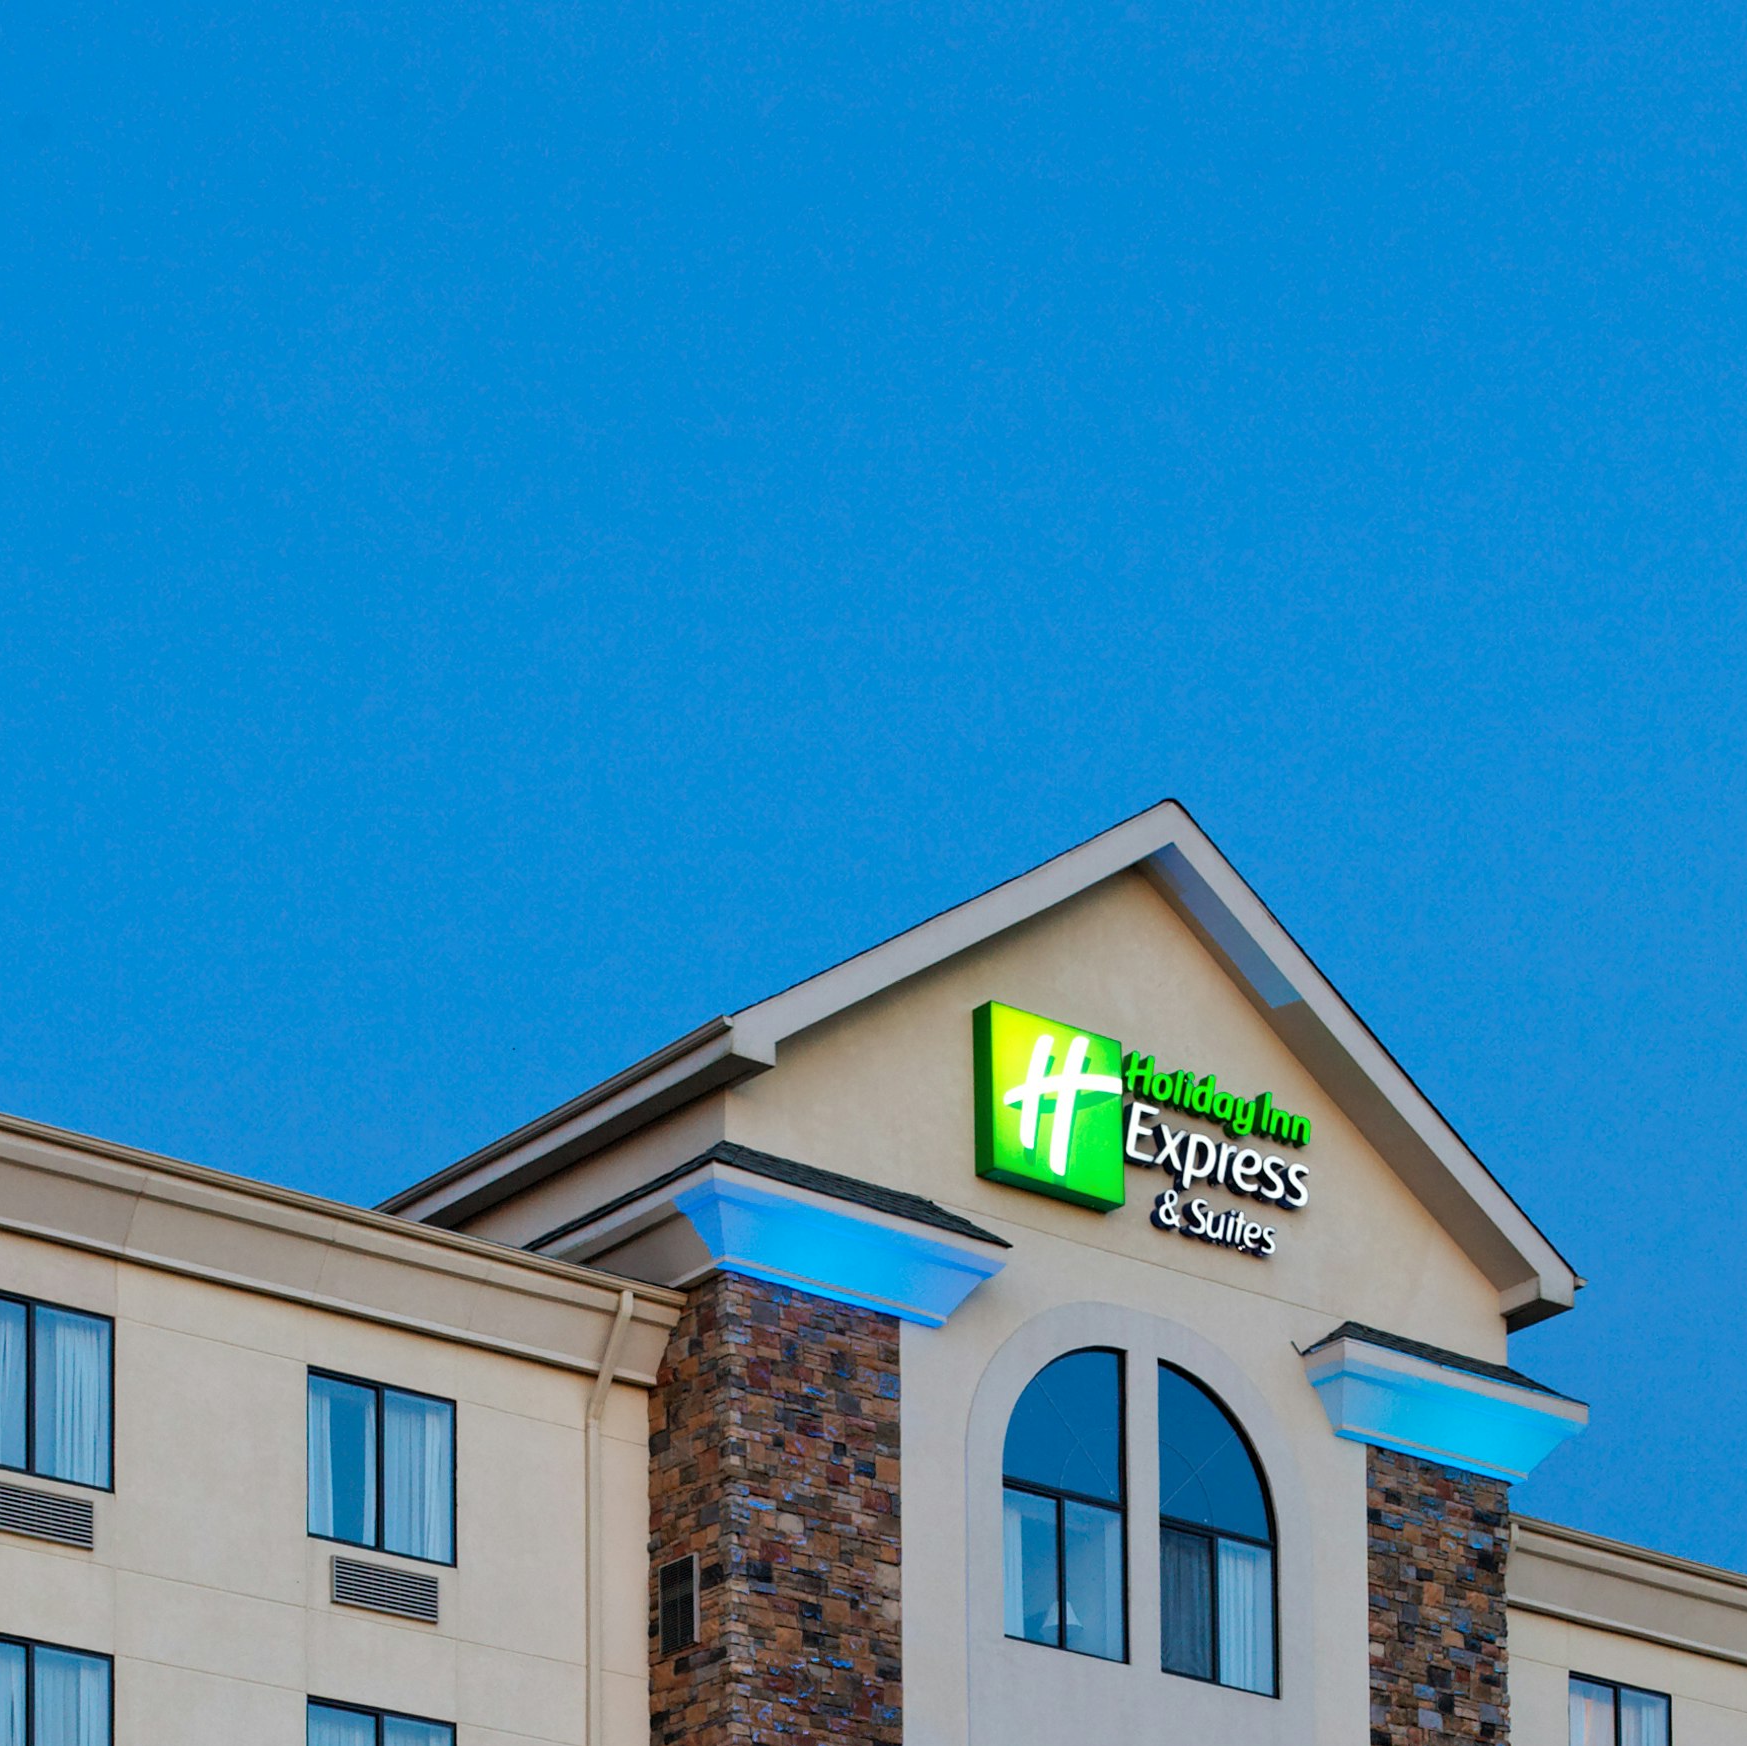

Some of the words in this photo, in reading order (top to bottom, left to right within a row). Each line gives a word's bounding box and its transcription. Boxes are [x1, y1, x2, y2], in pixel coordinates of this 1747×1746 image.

[1124, 1051, 1256, 1136] Holiday
[1259, 1091, 1312, 1146] Inn
[1125, 1101, 1310, 1208] Express
[1157, 1189, 1182, 1228] &
[1188, 1198, 1277, 1255] Suites
